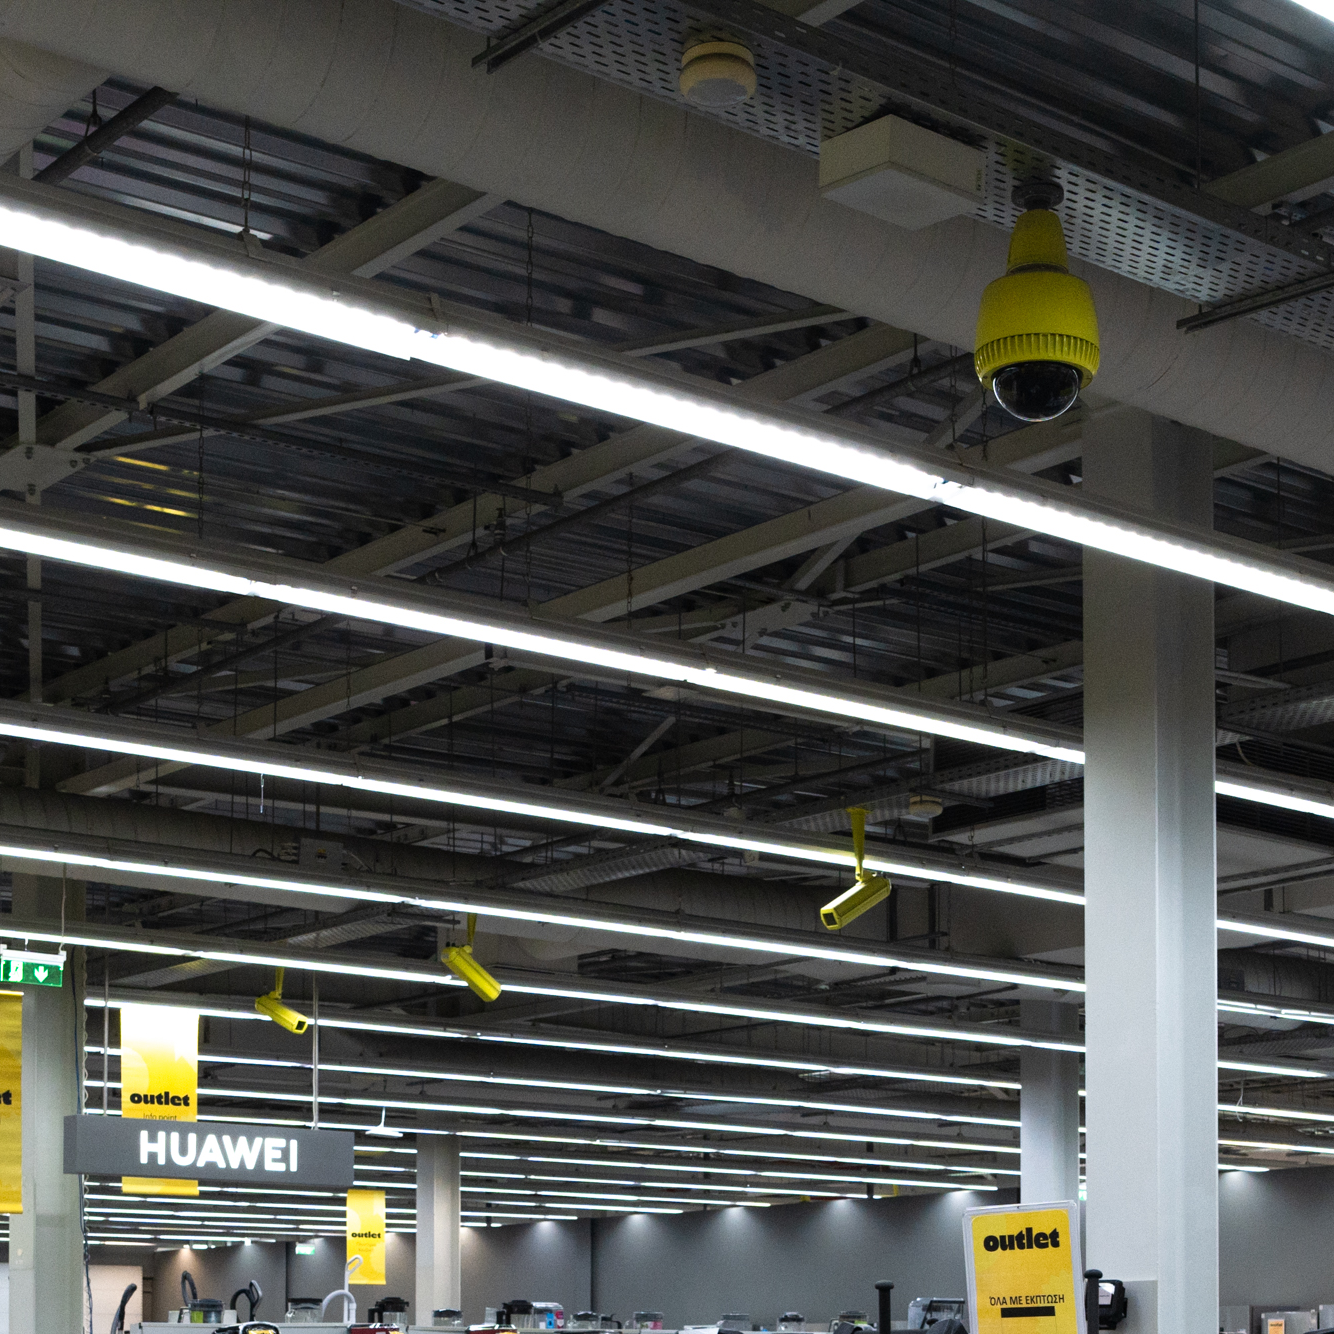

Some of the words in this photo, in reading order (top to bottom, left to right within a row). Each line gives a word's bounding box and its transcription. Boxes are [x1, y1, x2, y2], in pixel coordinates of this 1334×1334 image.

[130, 1091, 190, 1107] outlet
[140, 1130, 298, 1172] HUAWEI
[351, 1231, 381, 1239] outlet
[984, 1227, 1061, 1252] outlet
[1009, 1295, 1024, 1306] ΜΕ
[1025, 1294, 1065, 1305] ΕΚΠΤΩΣΗ
